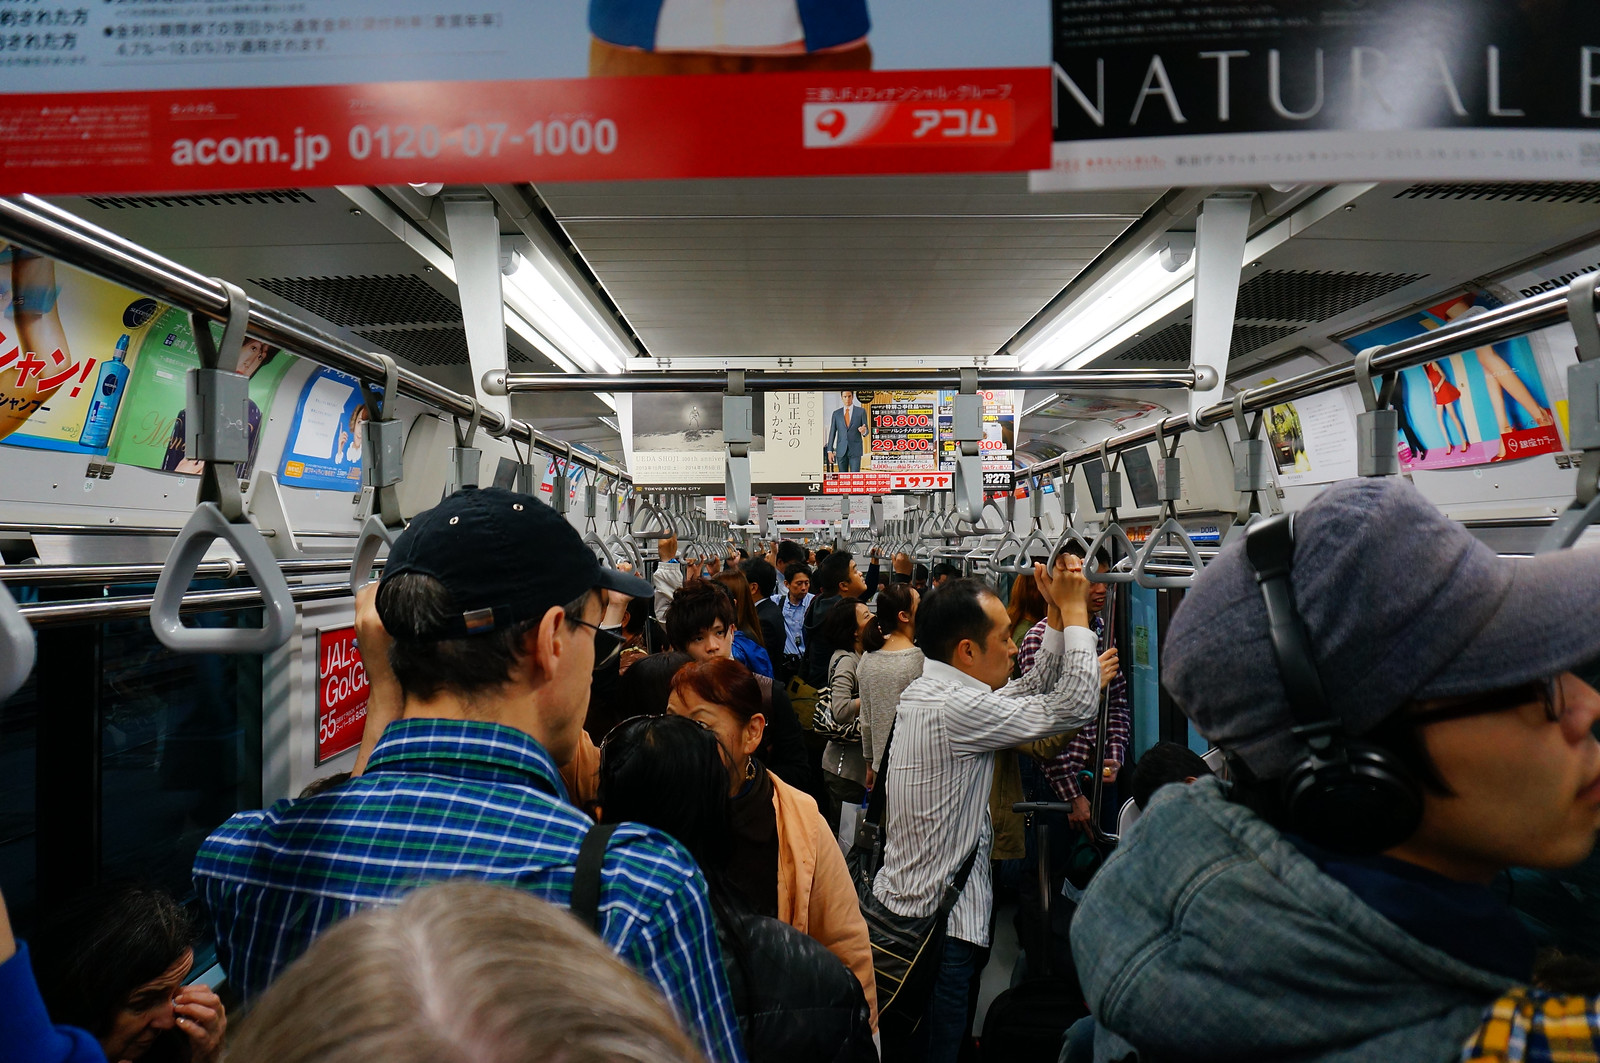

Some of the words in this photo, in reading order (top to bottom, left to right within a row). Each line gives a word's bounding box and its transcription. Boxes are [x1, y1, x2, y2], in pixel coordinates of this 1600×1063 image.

[1051, 45, 1526, 129] NATURAL
[911, 108, 999, 138] アコム
[171, 127, 331, 171] acom.jp
[808, 483, 821, 491] JR
[1200, 526, 1218, 534] DODA
[320, 638, 351, 680] JAL
